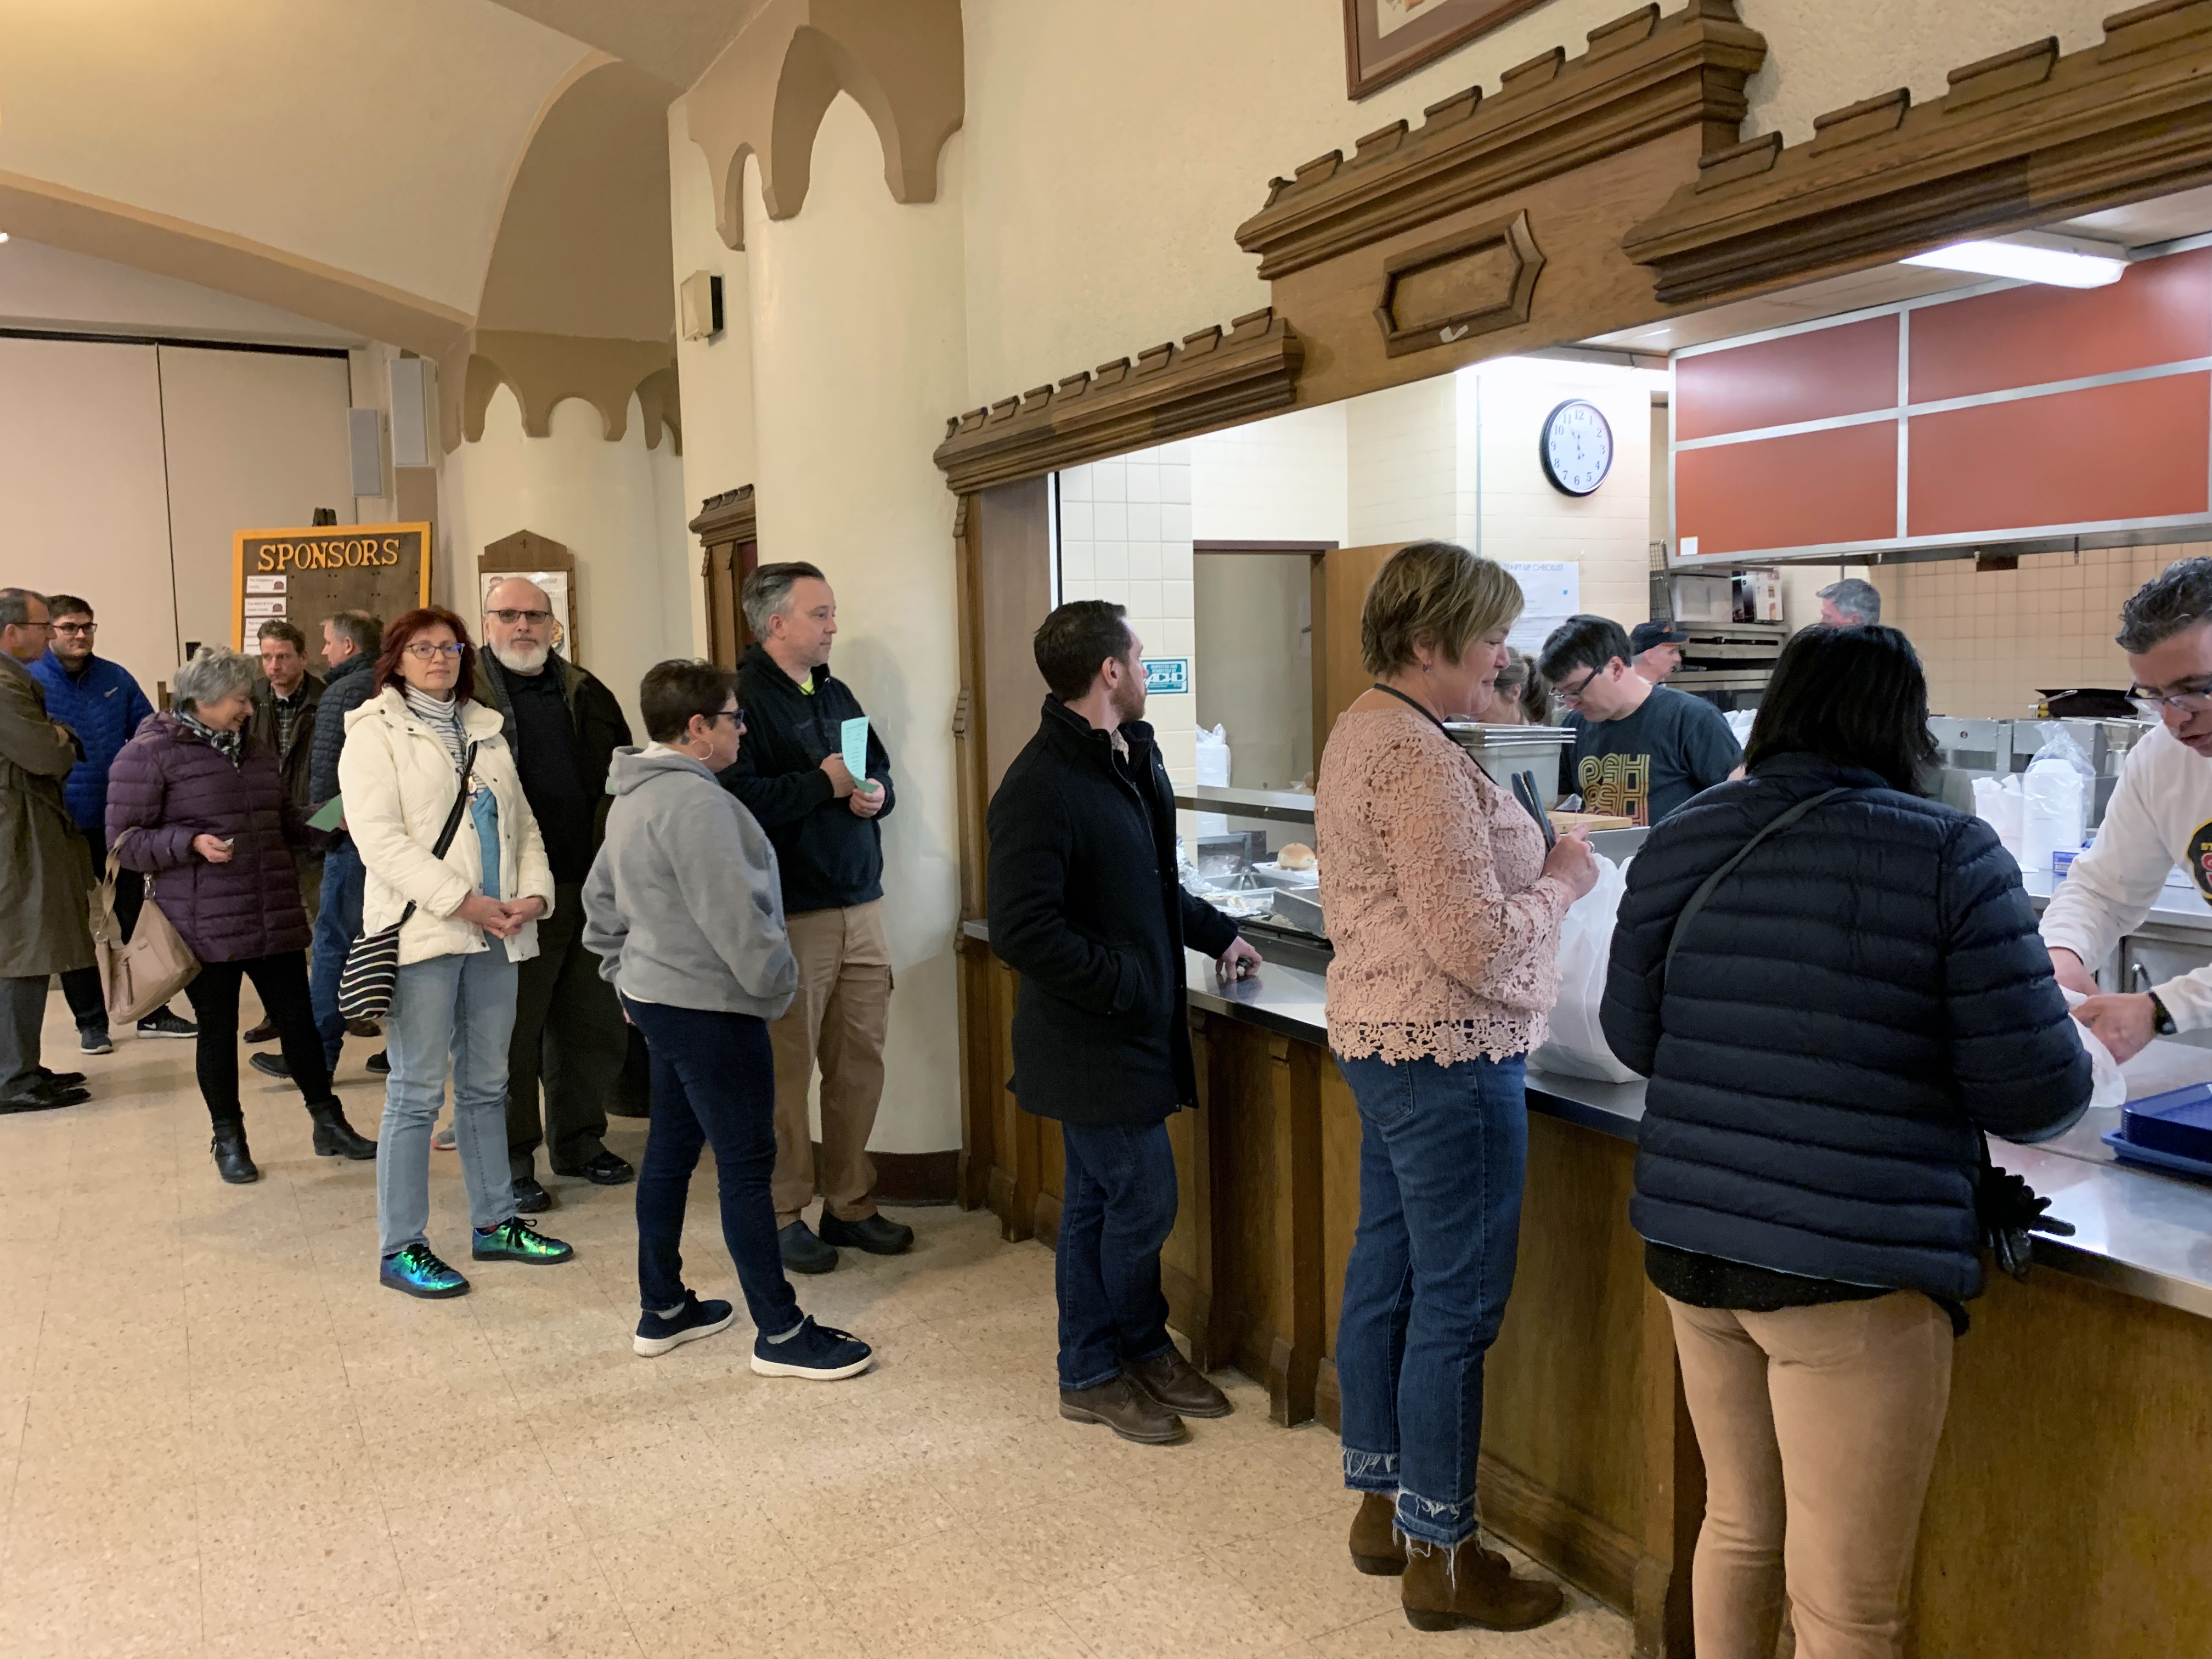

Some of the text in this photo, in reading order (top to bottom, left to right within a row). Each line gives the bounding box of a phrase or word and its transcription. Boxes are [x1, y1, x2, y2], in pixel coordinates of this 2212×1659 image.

[1563, 414, 1571, 424] 11
[1575, 410, 1584, 420] 12
[1589, 415, 1593, 425] 1
[1554, 425, 1564, 435] 10
[1596, 427, 1602, 437] 2
[1551, 441, 1556, 451] 9
[1600, 444, 1605, 455] 3
[1554, 458, 1560, 468] 8
[1595, 460, 1600, 470] 4
[1562, 470, 1568, 481] 7
[1574, 475, 1580, 486] 6
[1586, 472, 1592, 482] 5
[257, 539, 400, 571] SPONSORS
